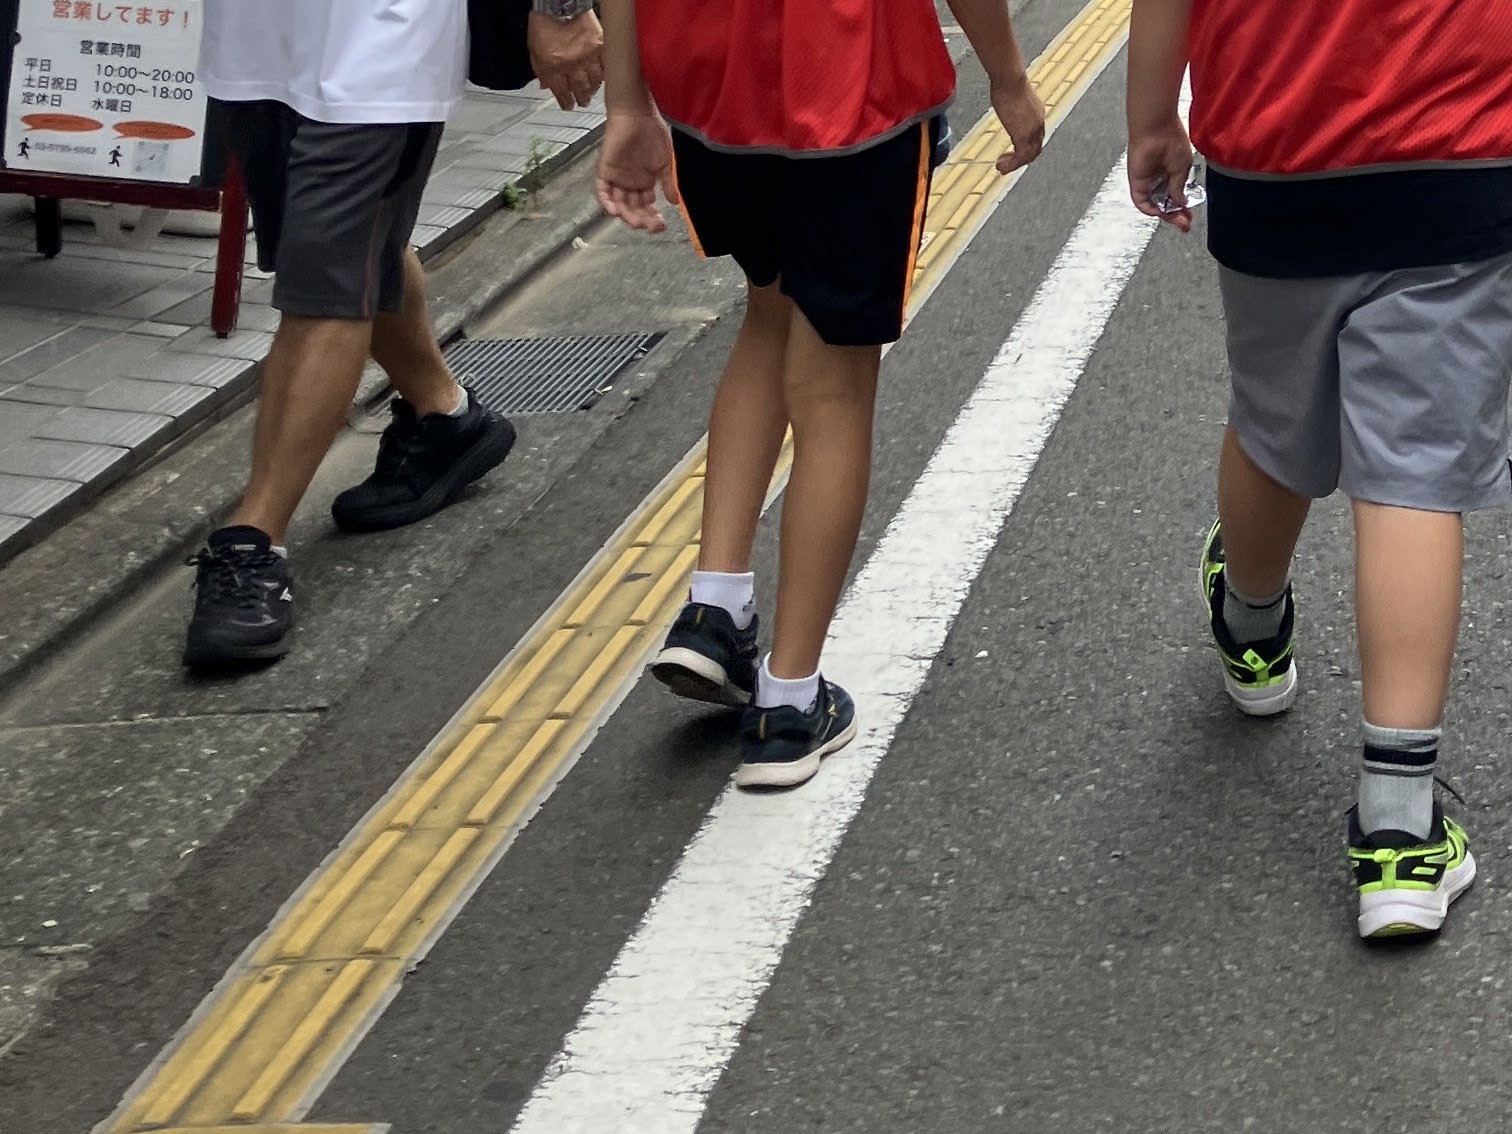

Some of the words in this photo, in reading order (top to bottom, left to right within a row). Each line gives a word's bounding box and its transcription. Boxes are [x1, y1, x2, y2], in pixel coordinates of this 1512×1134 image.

[79, 39, 142, 60] 営業時間
[24, 56, 52, 74] 平日
[21, 74, 78, 92] 土日祝日
[20, 90, 63, 108] 定休日
[90, 96, 133, 114] 水曜日
